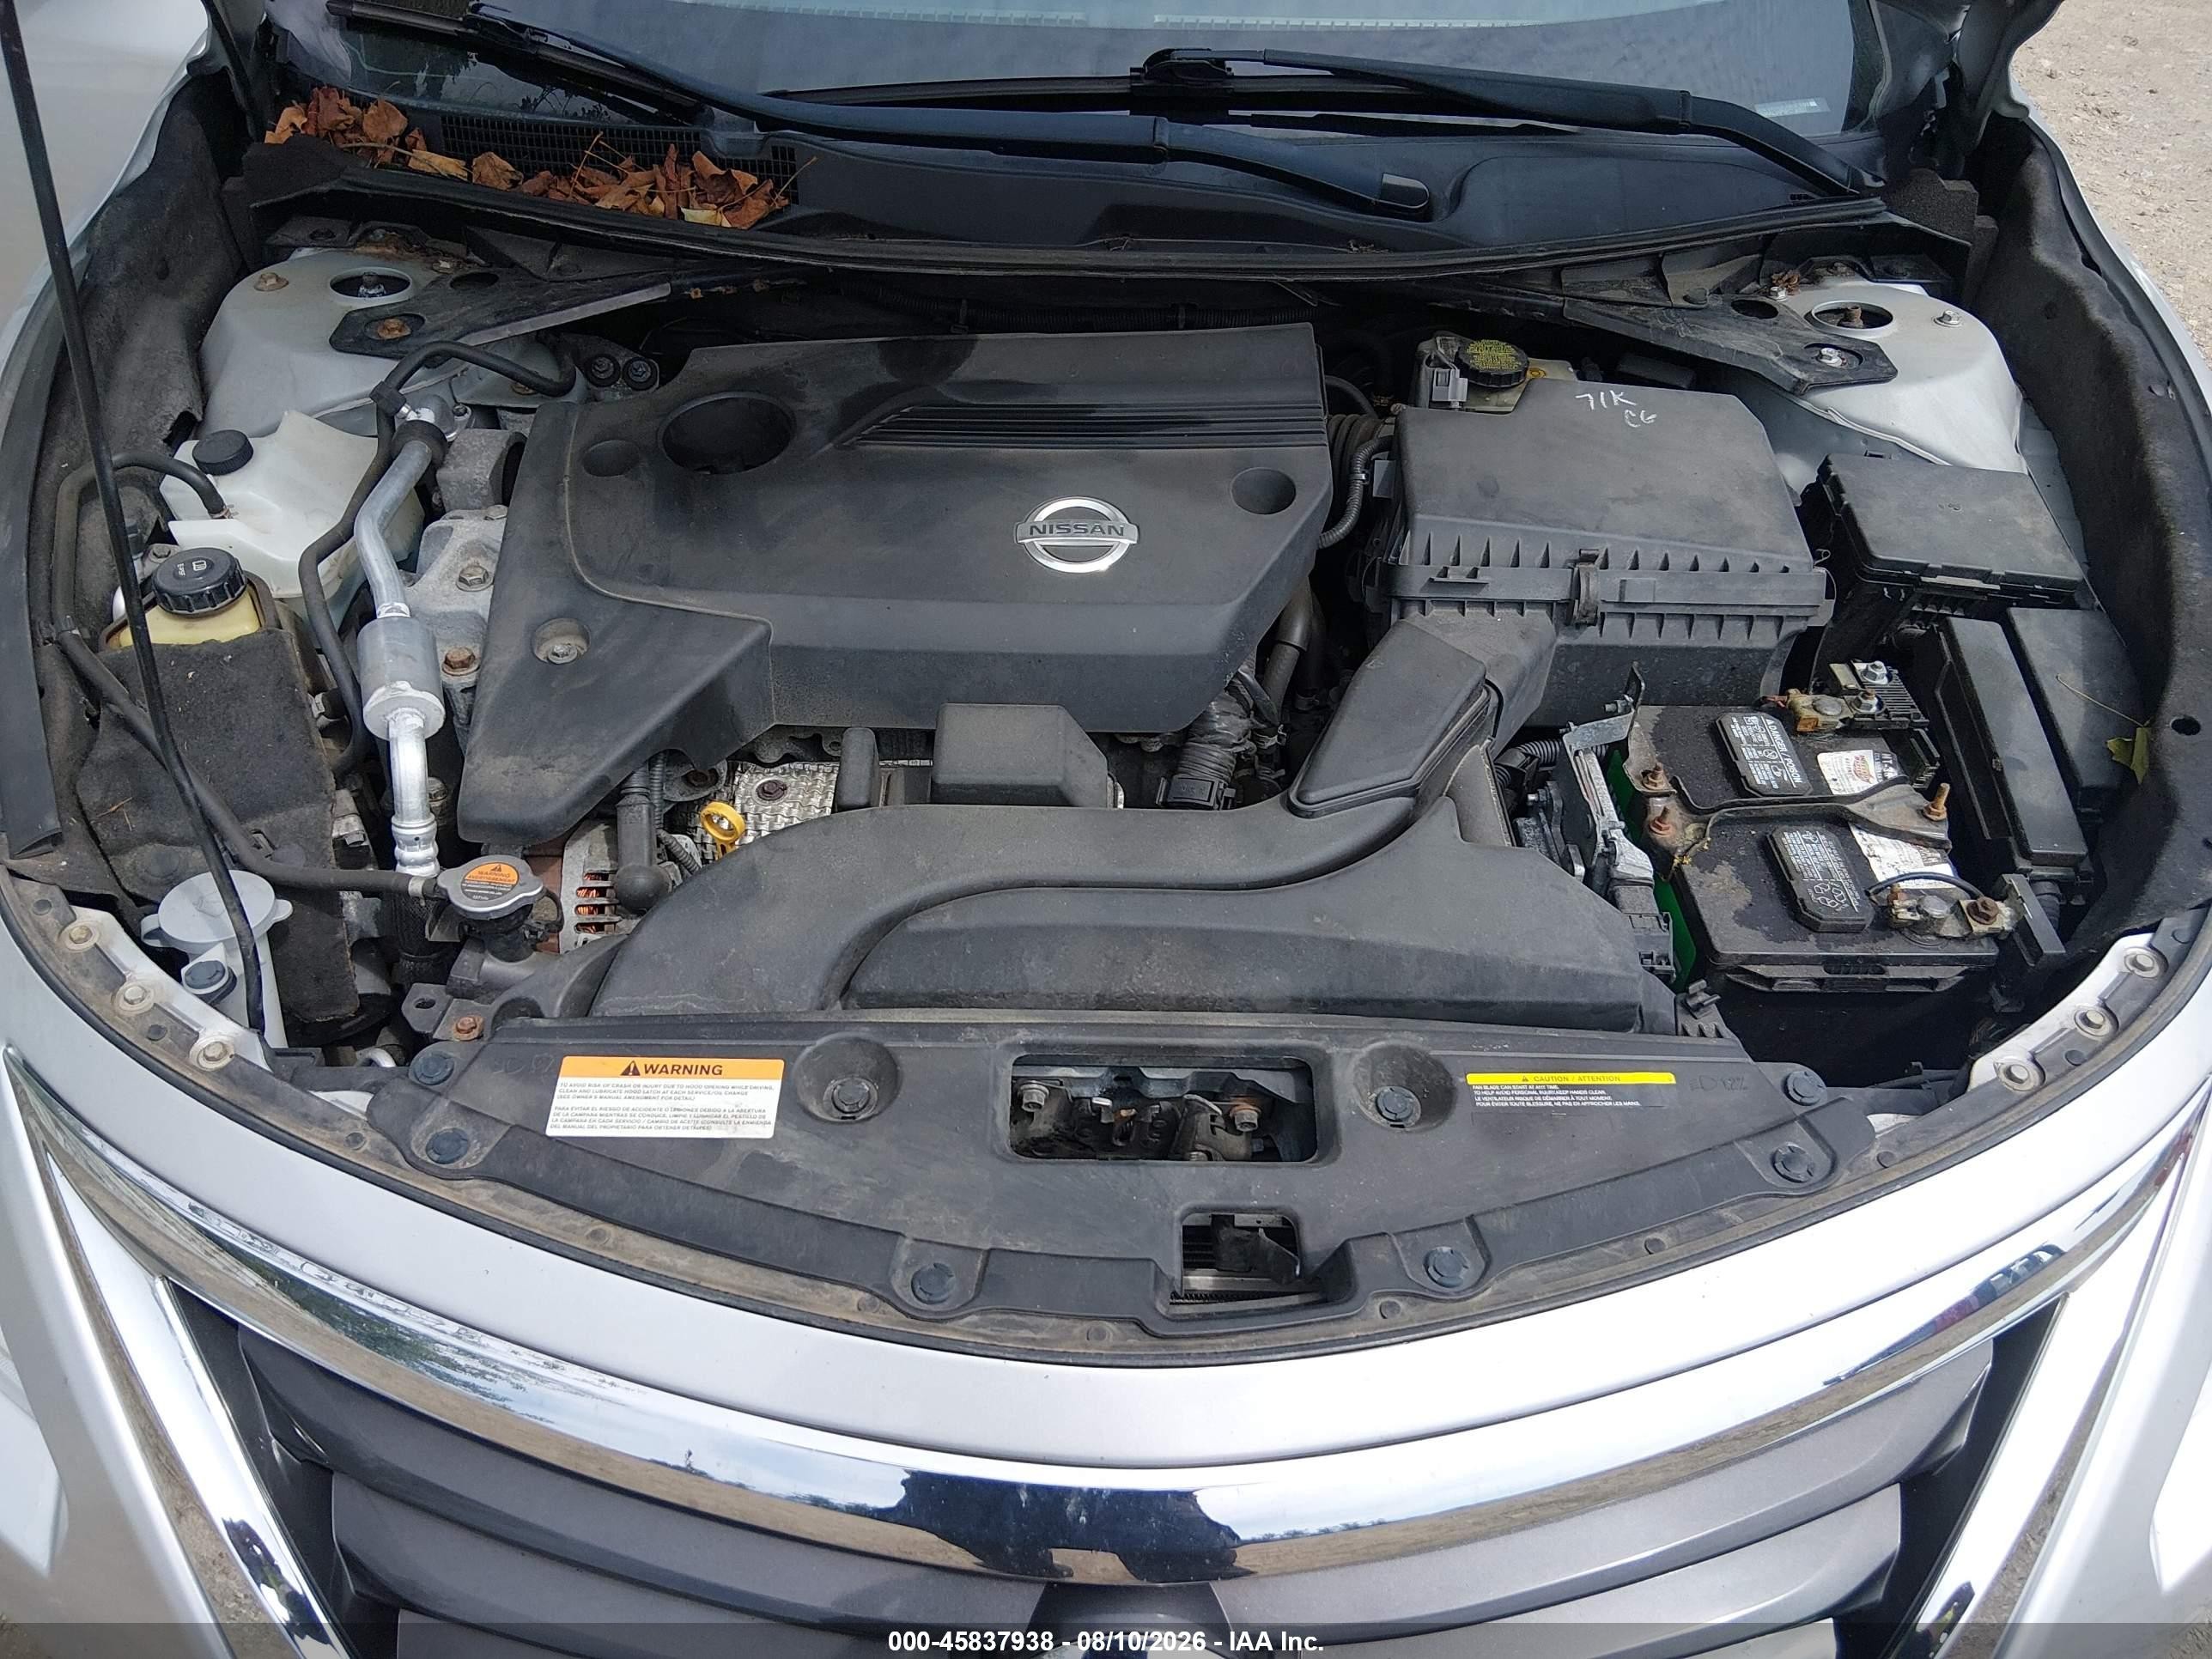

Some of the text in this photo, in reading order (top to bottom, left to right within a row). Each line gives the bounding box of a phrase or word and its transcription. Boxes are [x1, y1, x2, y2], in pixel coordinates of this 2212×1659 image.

[1030, 524, 1124, 536] NISSAN
[1768, 725, 1786, 751] DANGER
[1784, 758, 1802, 783] POISON
[644, 1064, 723, 1075] WARNING
